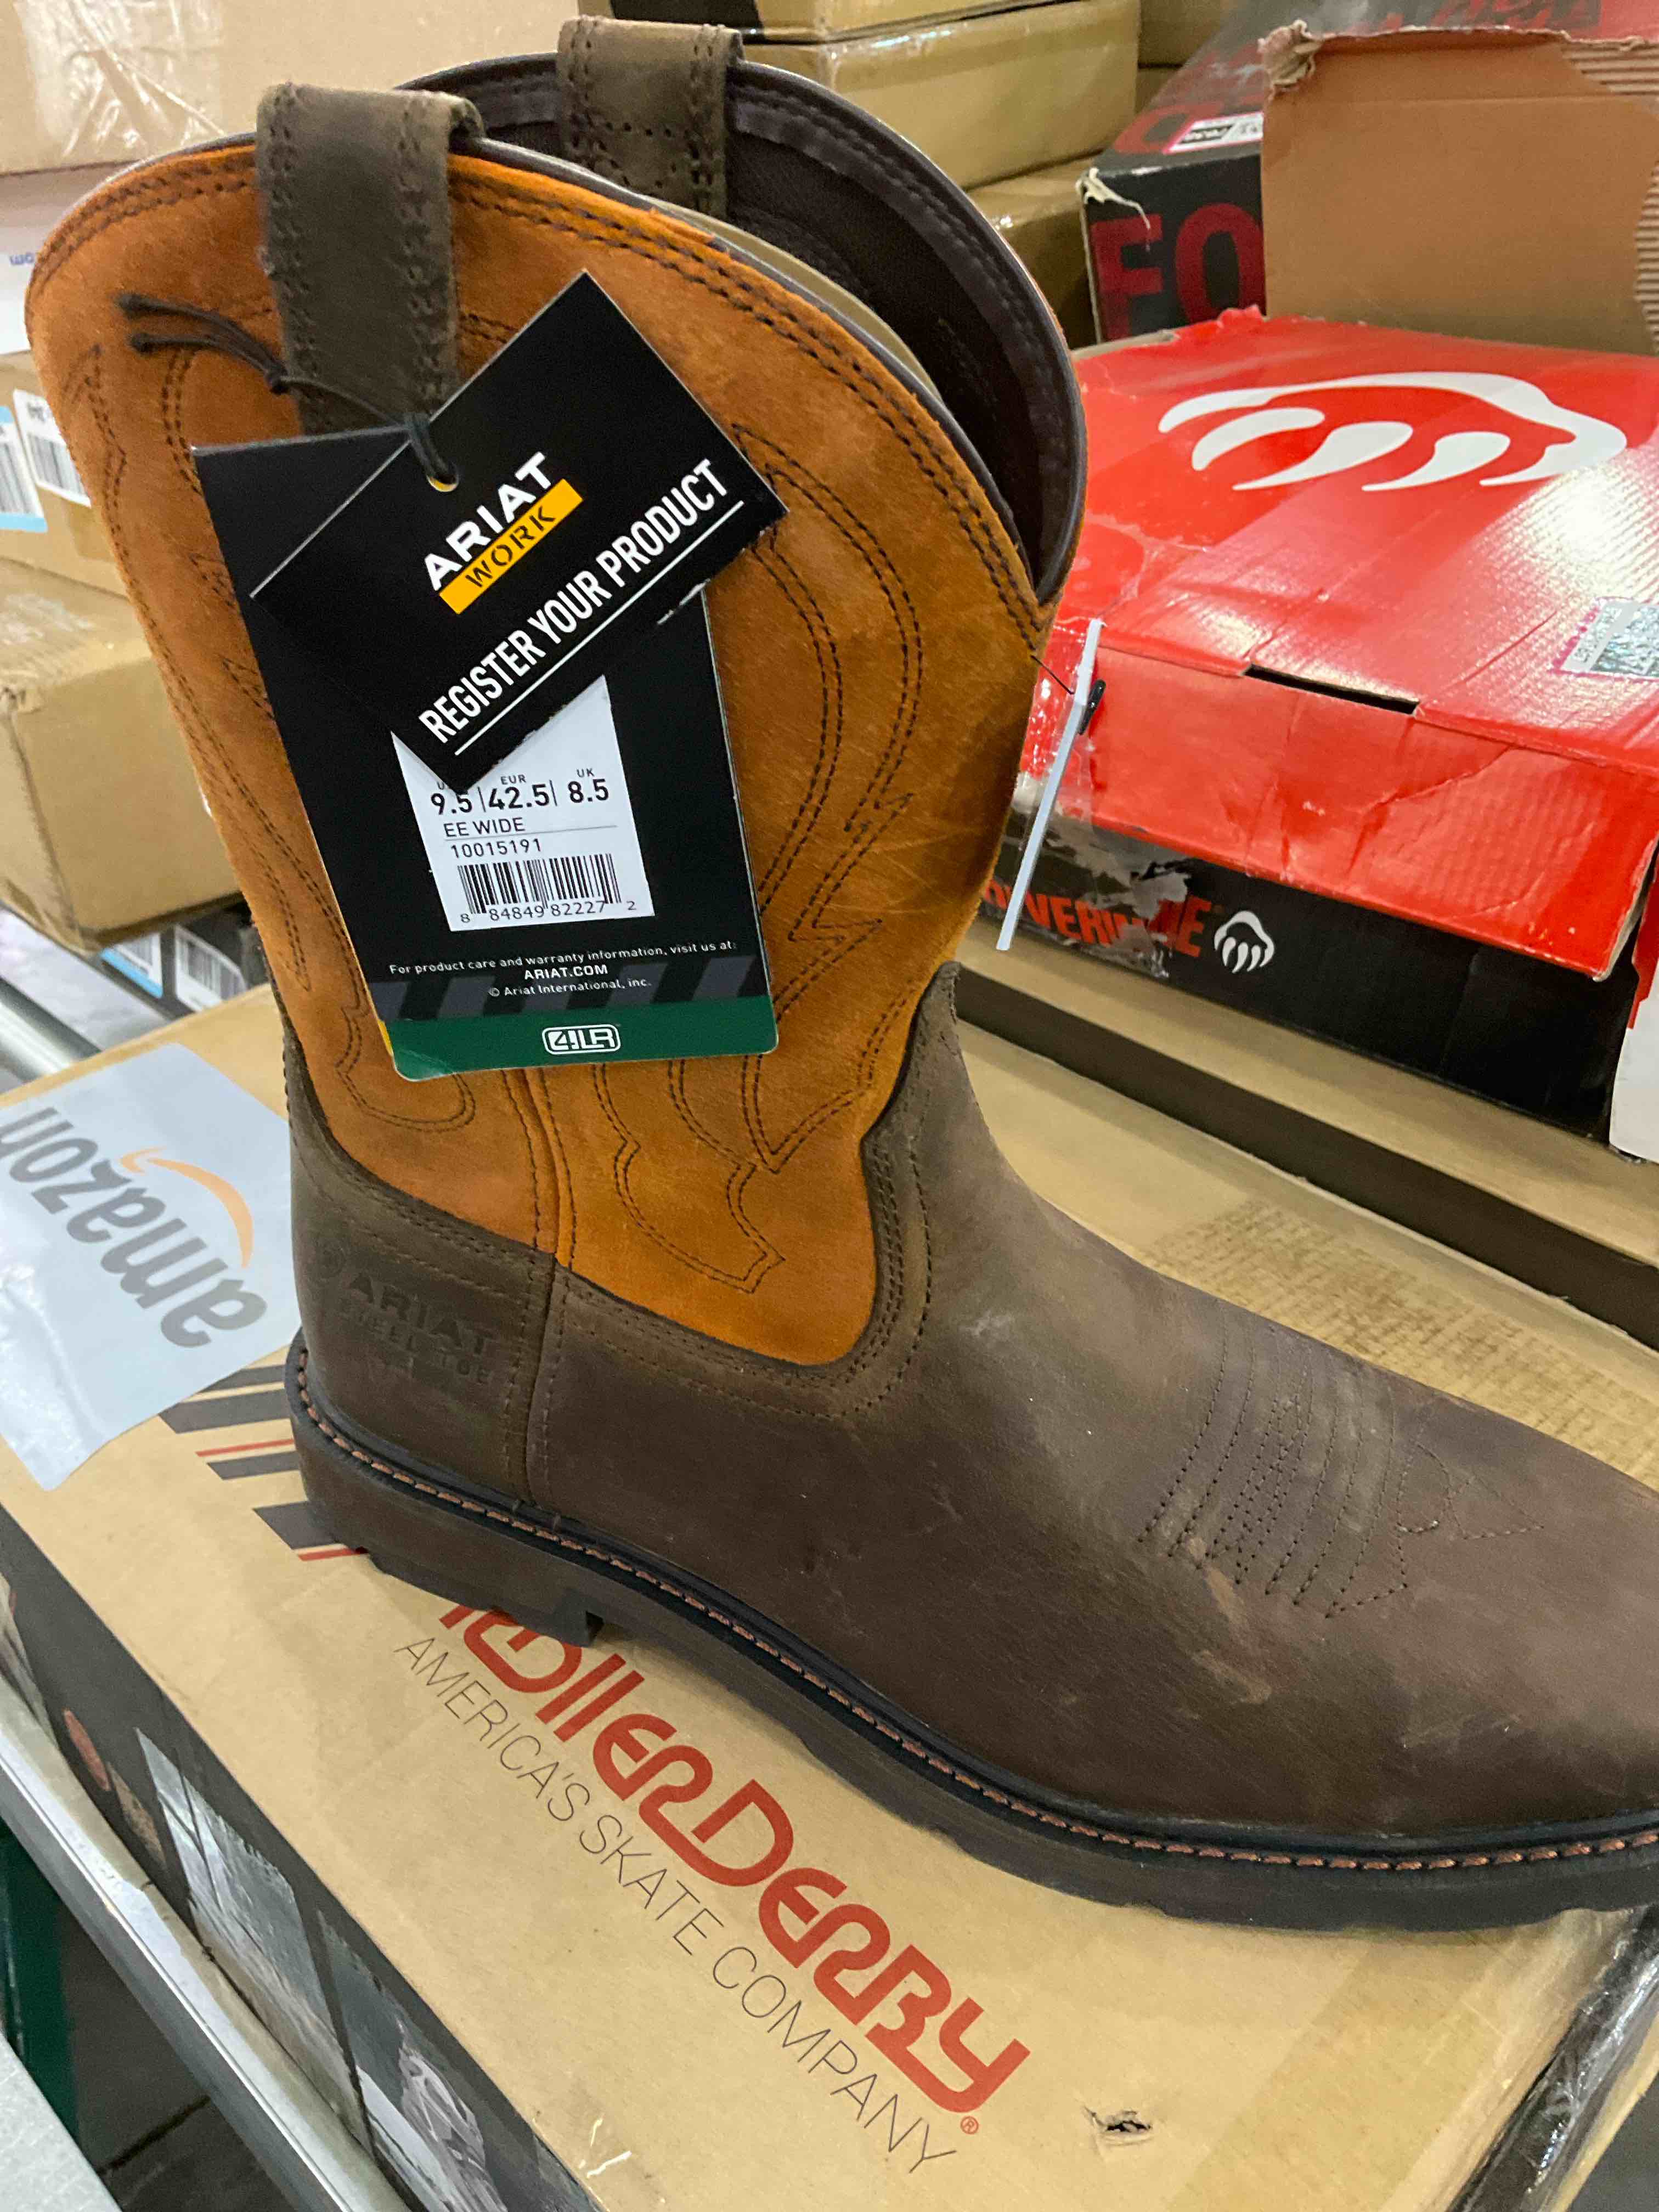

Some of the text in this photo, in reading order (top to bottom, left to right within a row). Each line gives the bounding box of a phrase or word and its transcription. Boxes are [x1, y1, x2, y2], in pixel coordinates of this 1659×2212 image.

[425, 452, 551, 591] ARIAT
[465, 505, 556, 588] WORK
[419, 459, 727, 743] REGISTER YOUR PRODUCT
[500, 775, 527, 785] EUR
[576, 768, 595, 778] UK
[431, 778, 609, 815] 9.5 42.5 8.5
[443, 817, 526, 837] EE WIDE
[451, 838, 543, 859] 10015191
[627, 901, 637, 912] 2
[388, 964, 411, 974] For
[415, 961, 465, 975] product
[468, 960, 496, 970] care
[499, 956, 523, 967] and
[525, 953, 584, 967] warranty
[588, 947, 668, 961] information,
[669, 943, 697, 954] visit
[701, 943, 716, 952] us
[524, 964, 608, 980] ARIAT.COM
[504, 984, 537, 997] Ariat
[537, 978, 625, 994] International,
[0, 1107, 268, 1348] amazon
[347, 1271, 495, 1356] ARIAT
[394, 1634, 957, 2174] AMERICA'S SKATE COMPANY
